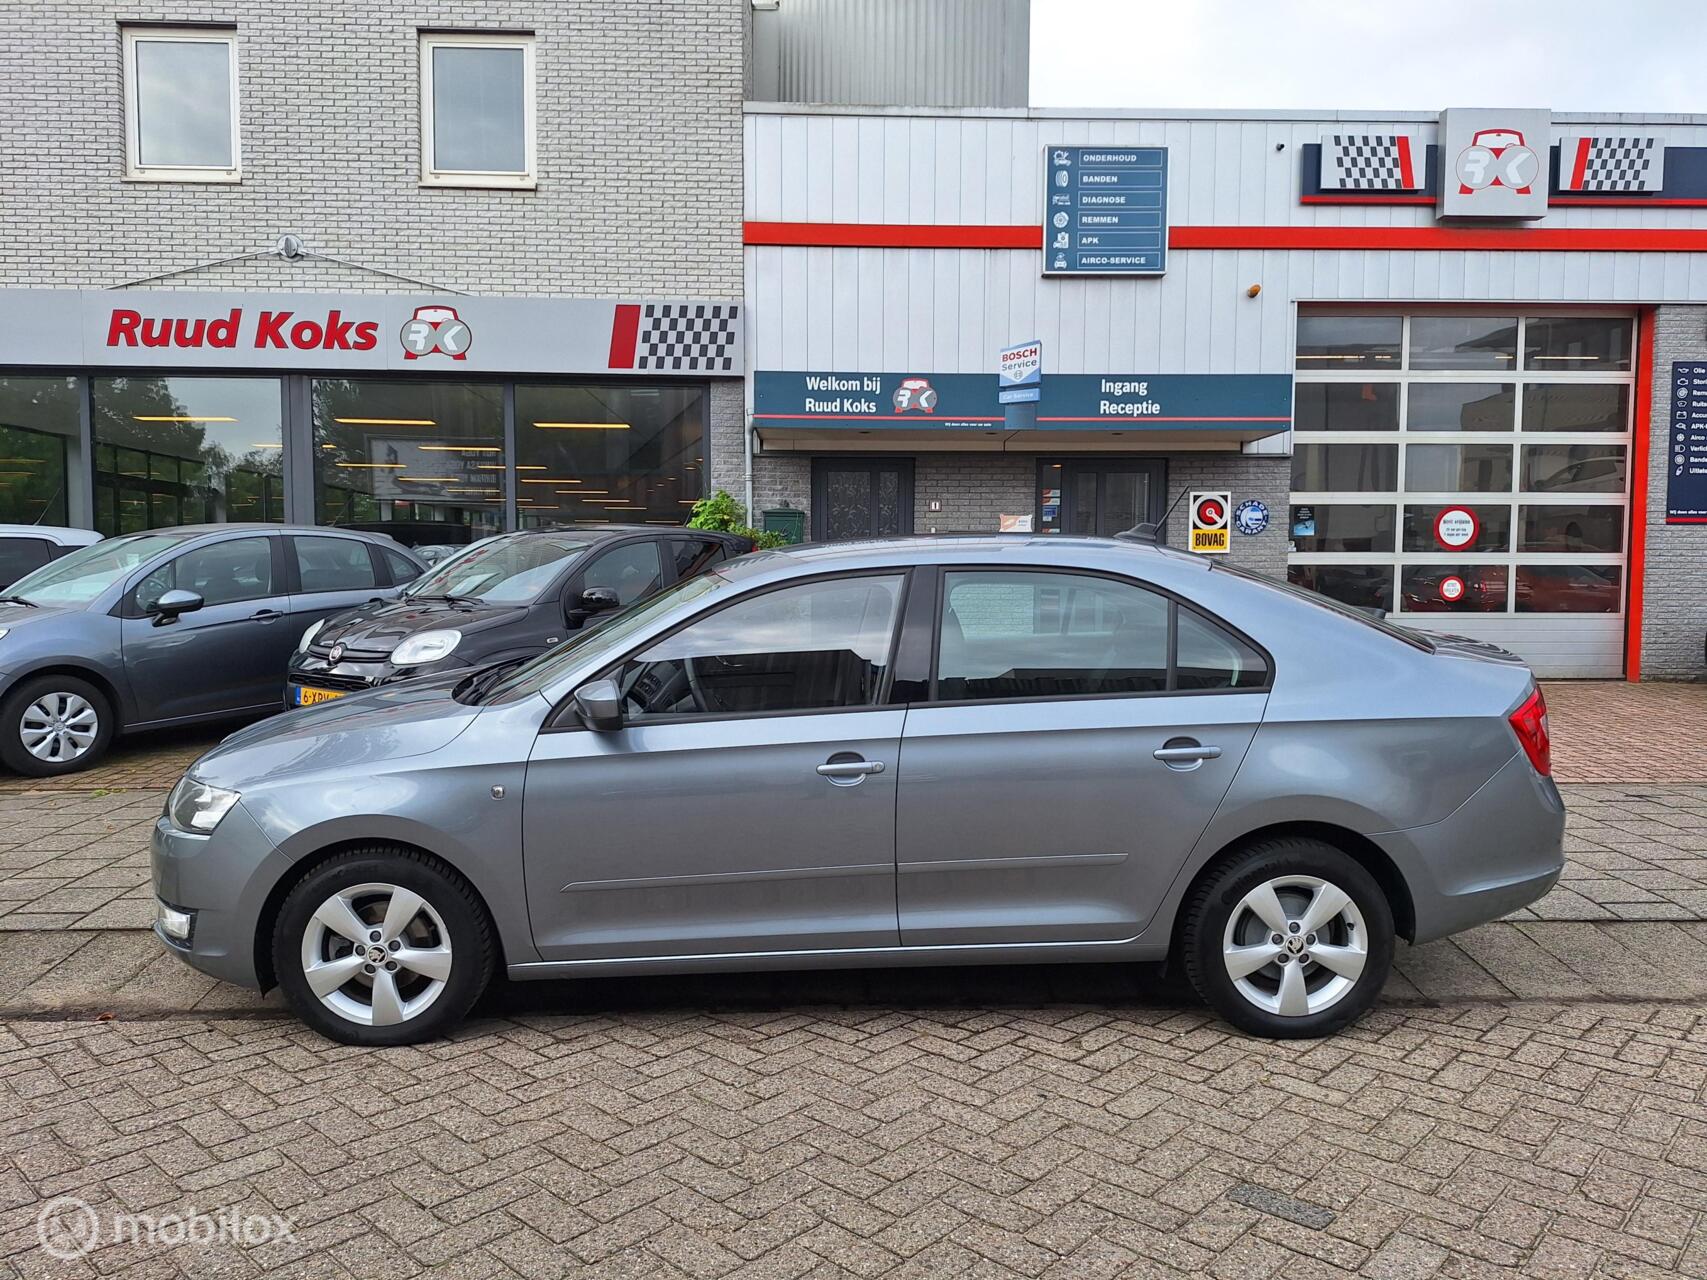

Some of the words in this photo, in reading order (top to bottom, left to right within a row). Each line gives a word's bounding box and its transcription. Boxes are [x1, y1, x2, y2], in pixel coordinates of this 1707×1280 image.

[1083, 154, 1137, 162] ONDERHOUD
[1082, 175, 1118, 183] BANDEN
[1082, 196, 1126, 204] DIAGNOSE
[1081, 216, 1119, 224] REMMEN
[106, 308, 243, 348] Ruud
[253, 310, 379, 351] Koks
[1002, 347, 1037, 362] BOSCH
[1002, 359, 1037, 371] Service
[806, 376, 861, 391] Welkom
[863, 376, 881, 394] bij
[1101, 379, 1148, 396] Ingang
[805, 398, 841, 413] Ruud
[843, 398, 877, 414] Koks
[1100, 400, 1161, 417] Receptie
[1236, 501, 1268, 516] SCHADE
[1195, 533, 1225, 547] BOVAG
